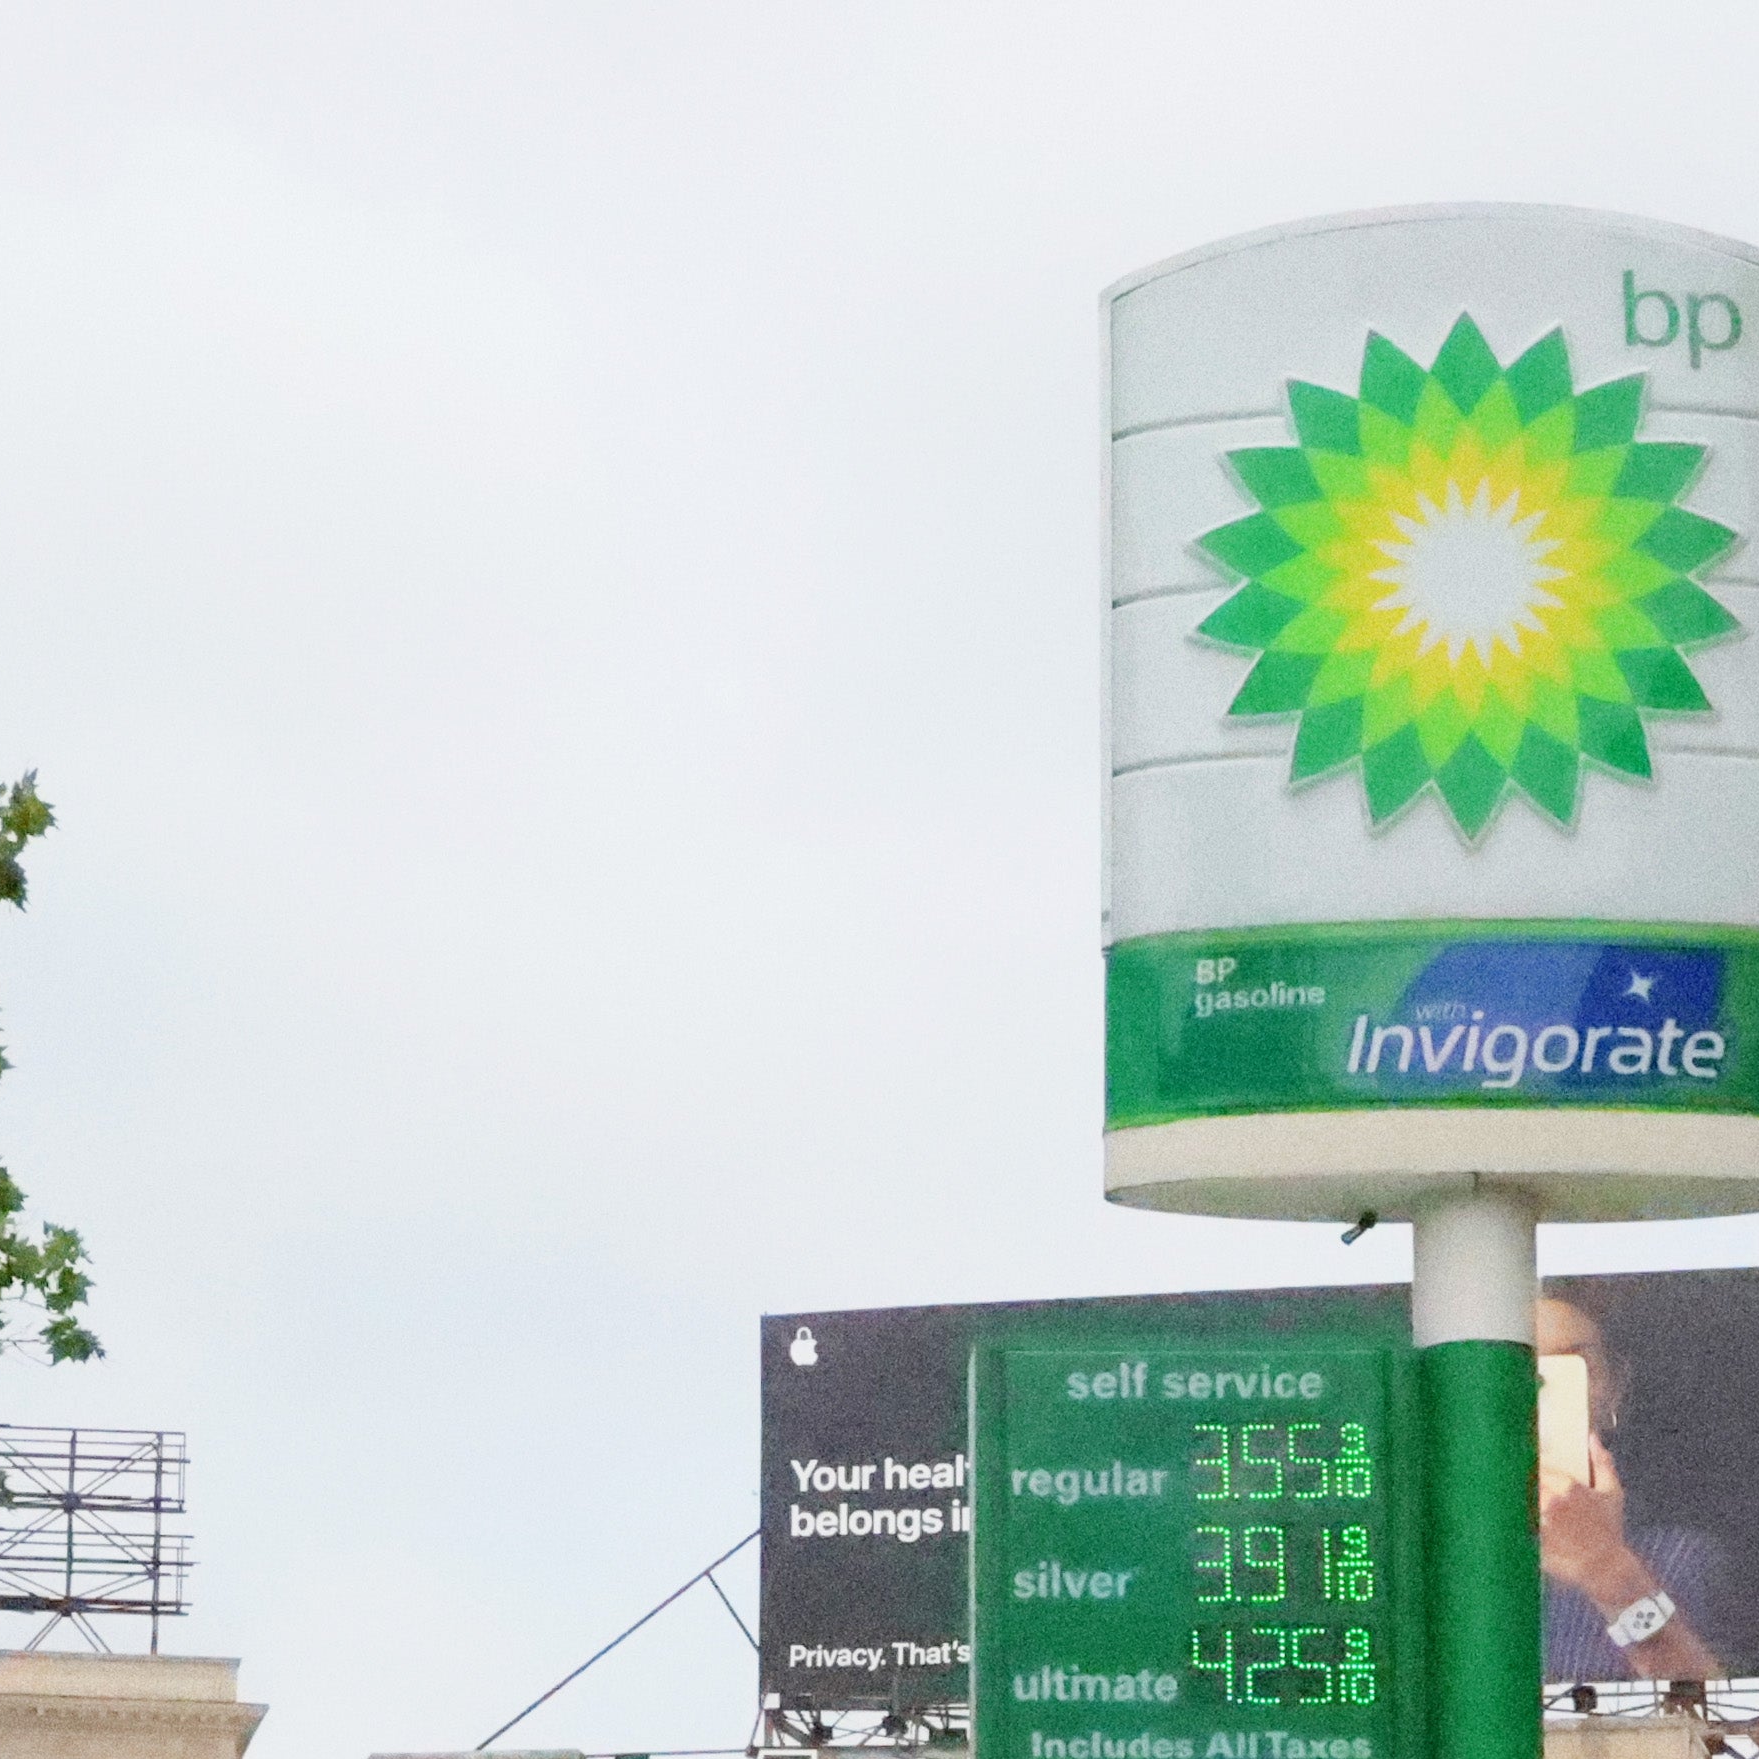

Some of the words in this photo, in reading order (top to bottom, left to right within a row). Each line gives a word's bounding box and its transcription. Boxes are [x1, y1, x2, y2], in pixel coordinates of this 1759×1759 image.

[1623, 269, 1742, 370] bp
[1195, 957, 1237, 985] BP
[1194, 981, 1326, 1017] gasoline
[1414, 1000, 1467, 1020] with
[1346, 1010, 1726, 1089] Invigorate
[1066, 1361, 1149, 1400] self
[1162, 1363, 1324, 1400] service
[790, 1458, 878, 1493] Your
[883, 1453, 971, 1491] heal
[1010, 1459, 1169, 1506] regular
[790, 1502, 945, 1543] belongs
[1013, 1560, 1132, 1600] silver
[789, 1643, 887, 1672] Privacy.
[890, 1639, 972, 1666] That's
[1013, 1663, 1180, 1702] ultimate
[1205, 1731, 1259, 1759] All
